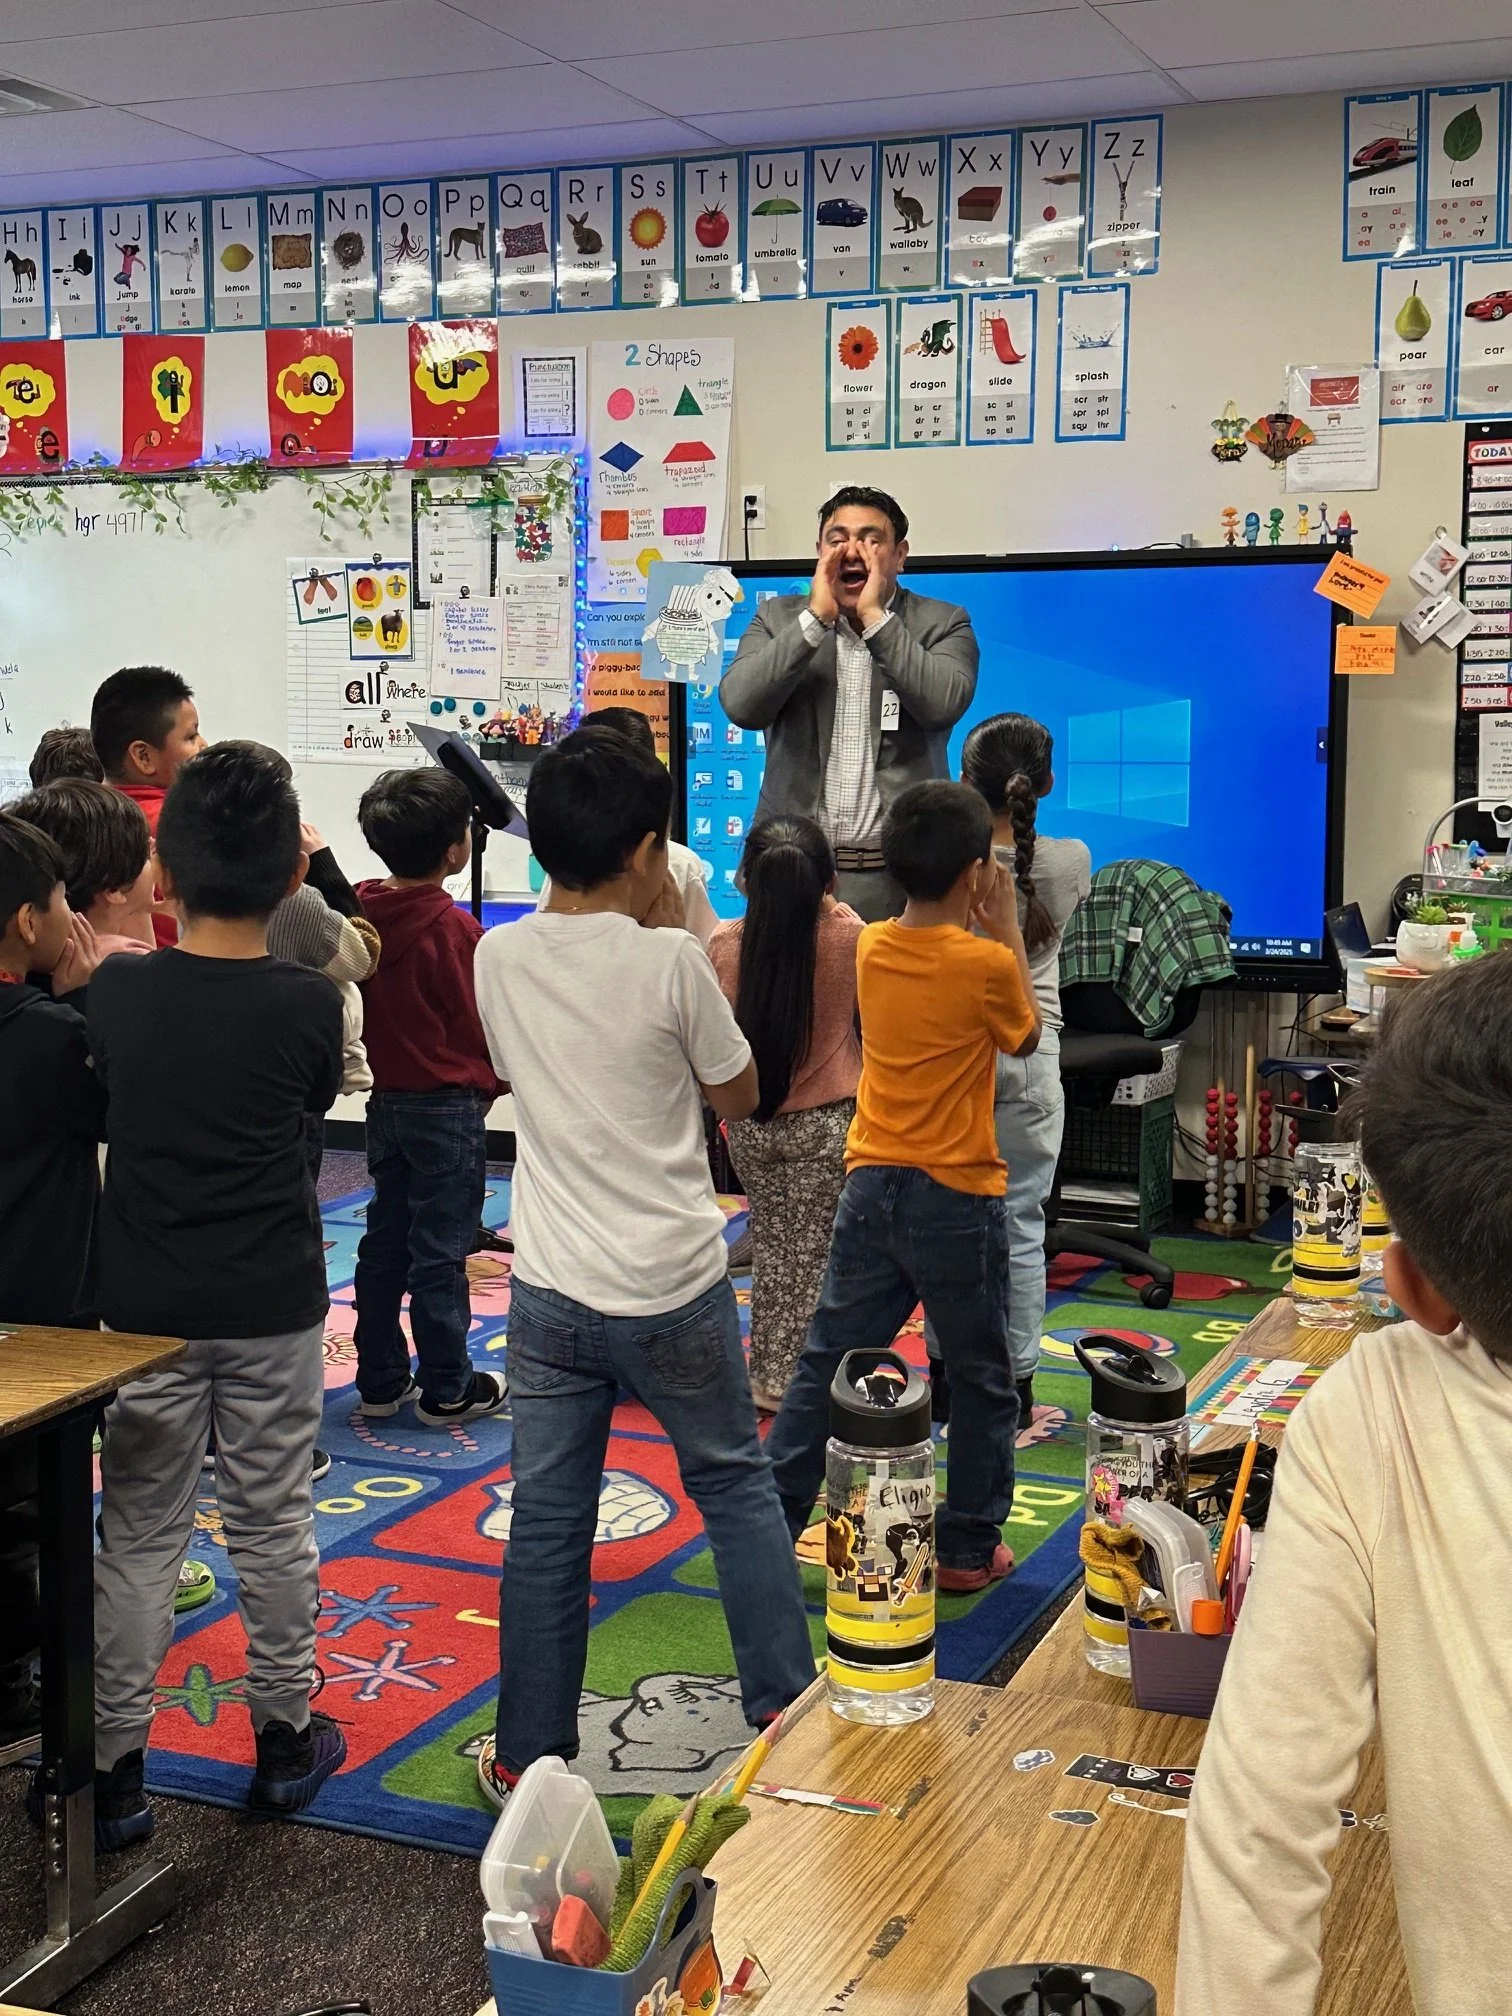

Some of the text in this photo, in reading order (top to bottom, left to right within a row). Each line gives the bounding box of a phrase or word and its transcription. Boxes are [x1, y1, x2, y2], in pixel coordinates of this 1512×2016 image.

[1451, 177, 1474, 188] leaf
[1369, 185, 1396, 196] train
[1107, 221, 1141, 232] zipper
[833, 244, 851, 253] van
[889, 239, 929, 250] wallaby
[695, 252, 729, 262] tomato
[754, 248, 797, 257] umbrella
[640, 257, 657, 266] sun
[516, 265, 535, 275] quilt
[224, 283, 250, 293] lemon
[283, 280, 302, 291] map
[116, 289, 139, 302] jump
[169, 286, 196, 296] karate
[12, 295, 34, 304] horse
[69, 293, 82, 302] ink
[1484, 346, 1505, 355] car
[624, 343, 702, 371] 2 Shapes
[1399, 351, 1427, 362] pear
[988, 377, 1013, 386] slide
[1075, 371, 1109, 382] splash
[844, 384, 874, 393] flower
[909, 380, 946, 391] dragon
[1487, 385, 1499, 393] ar
[1074, 396, 1088, 404] scr
[914, 403, 942, 412] br cr
[1072, 409, 1087, 417] spr
[75, 507, 101, 537] hgr
[587, 614, 623, 623] Can you
[618, 638, 632, 646] not
[345, 671, 385, 705] all
[620, 688, 634, 696] like
[882, 703, 898, 718] 22
[343, 728, 384, 749] draw
